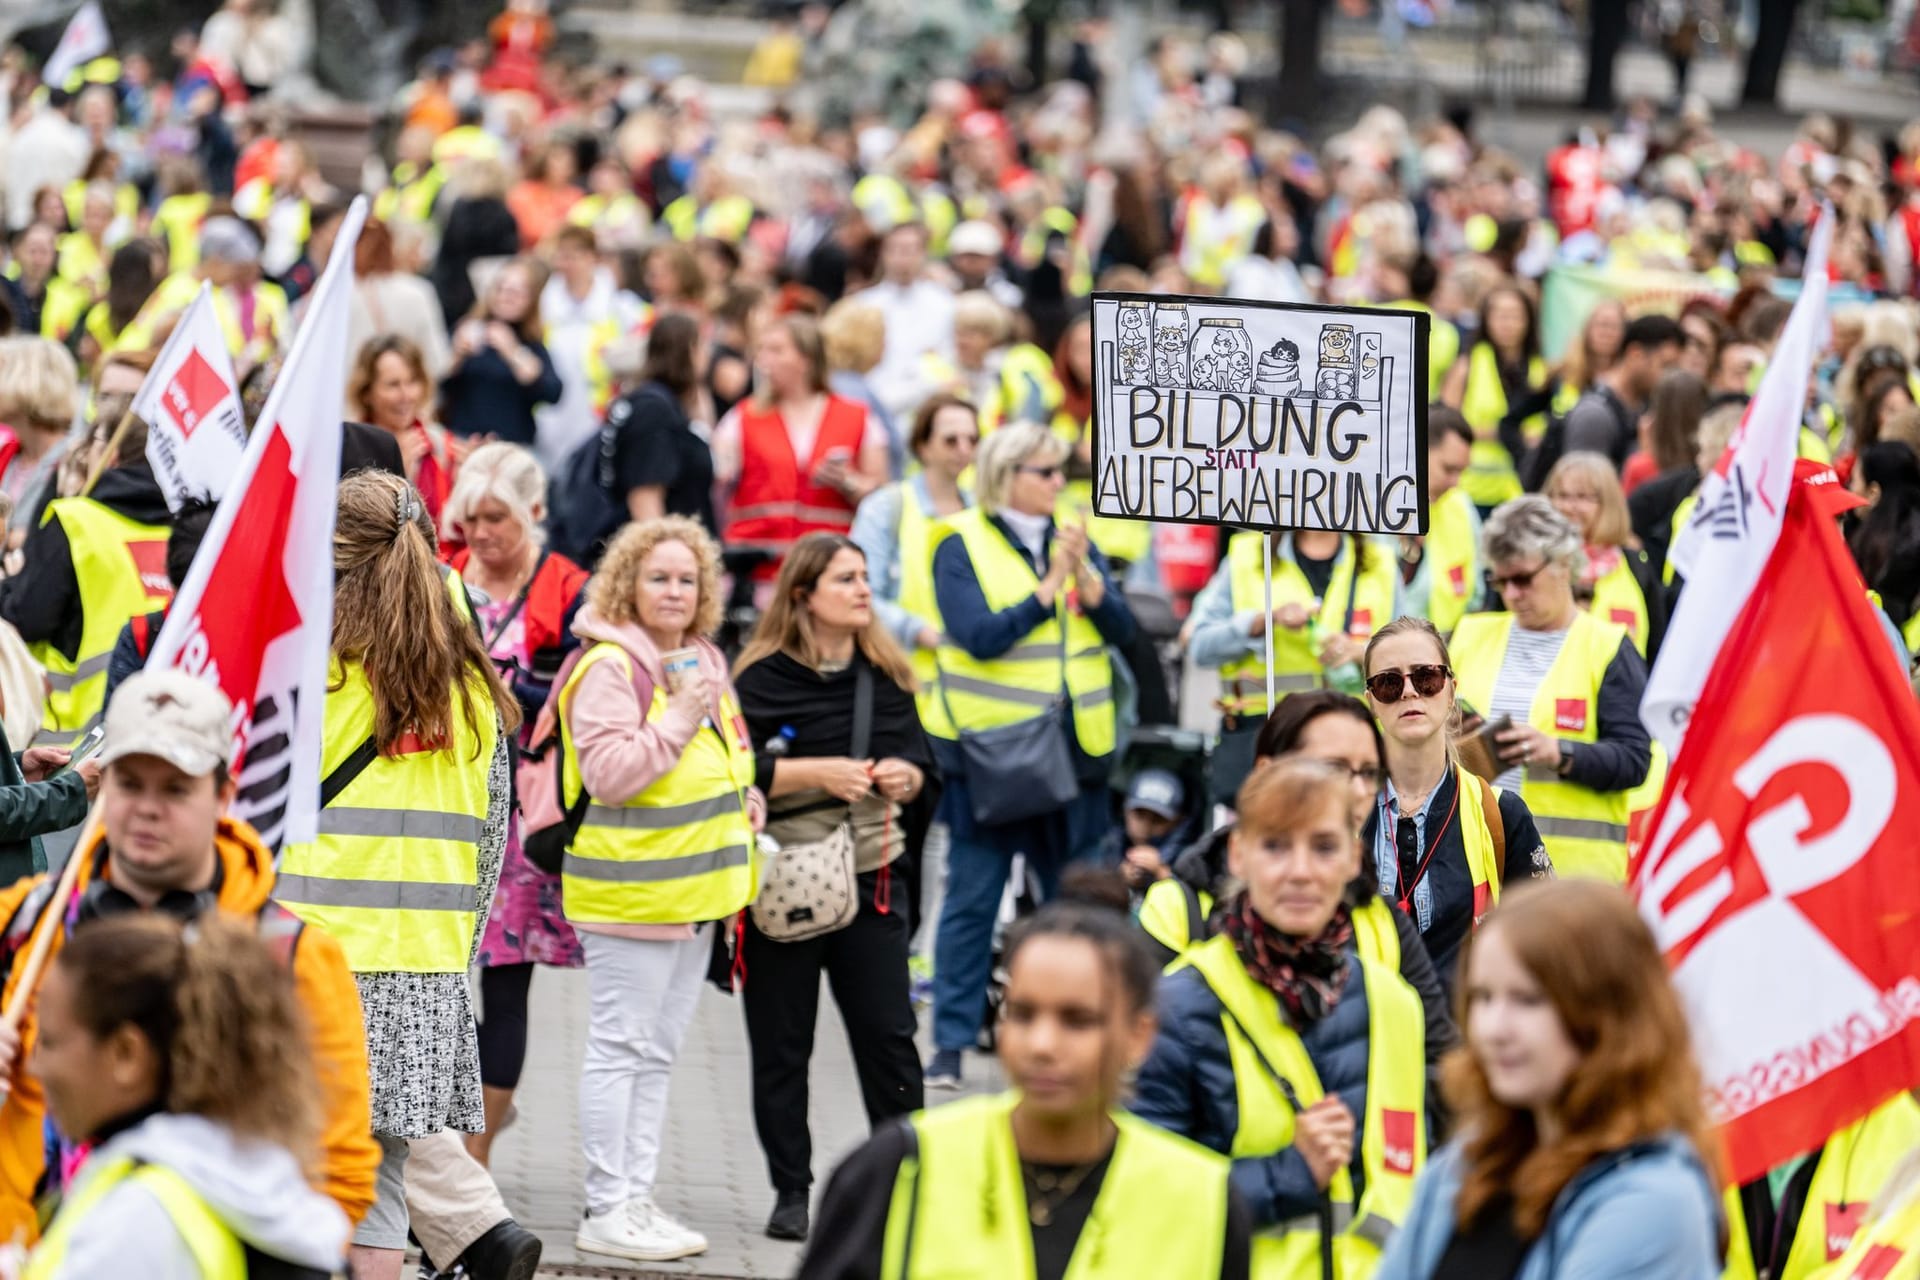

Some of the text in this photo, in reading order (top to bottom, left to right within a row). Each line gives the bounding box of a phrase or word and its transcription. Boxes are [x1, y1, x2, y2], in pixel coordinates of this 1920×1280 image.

[1129, 385, 1368, 462] BILDUNG
[1204, 448, 1260, 469] STATT
[1097, 454, 1417, 532] AUFBEWAHRUNG
